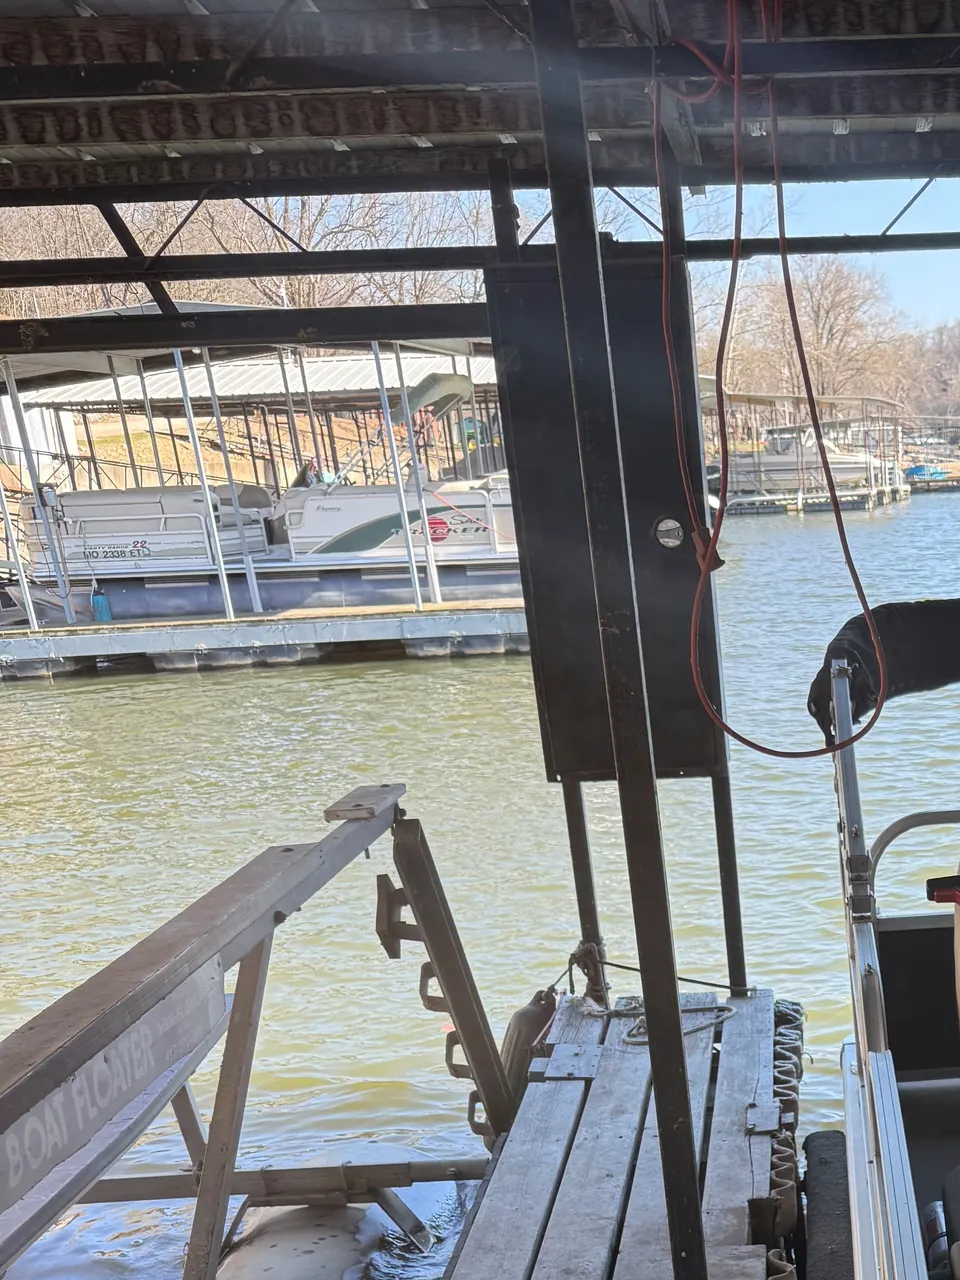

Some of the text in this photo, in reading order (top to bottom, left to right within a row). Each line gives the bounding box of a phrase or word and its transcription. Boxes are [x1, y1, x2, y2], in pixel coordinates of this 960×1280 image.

[132, 540, 147, 548] 22
[103, 550, 126, 559] 2338
[5, 1024, 156, 1189] BOAT FLOATER
